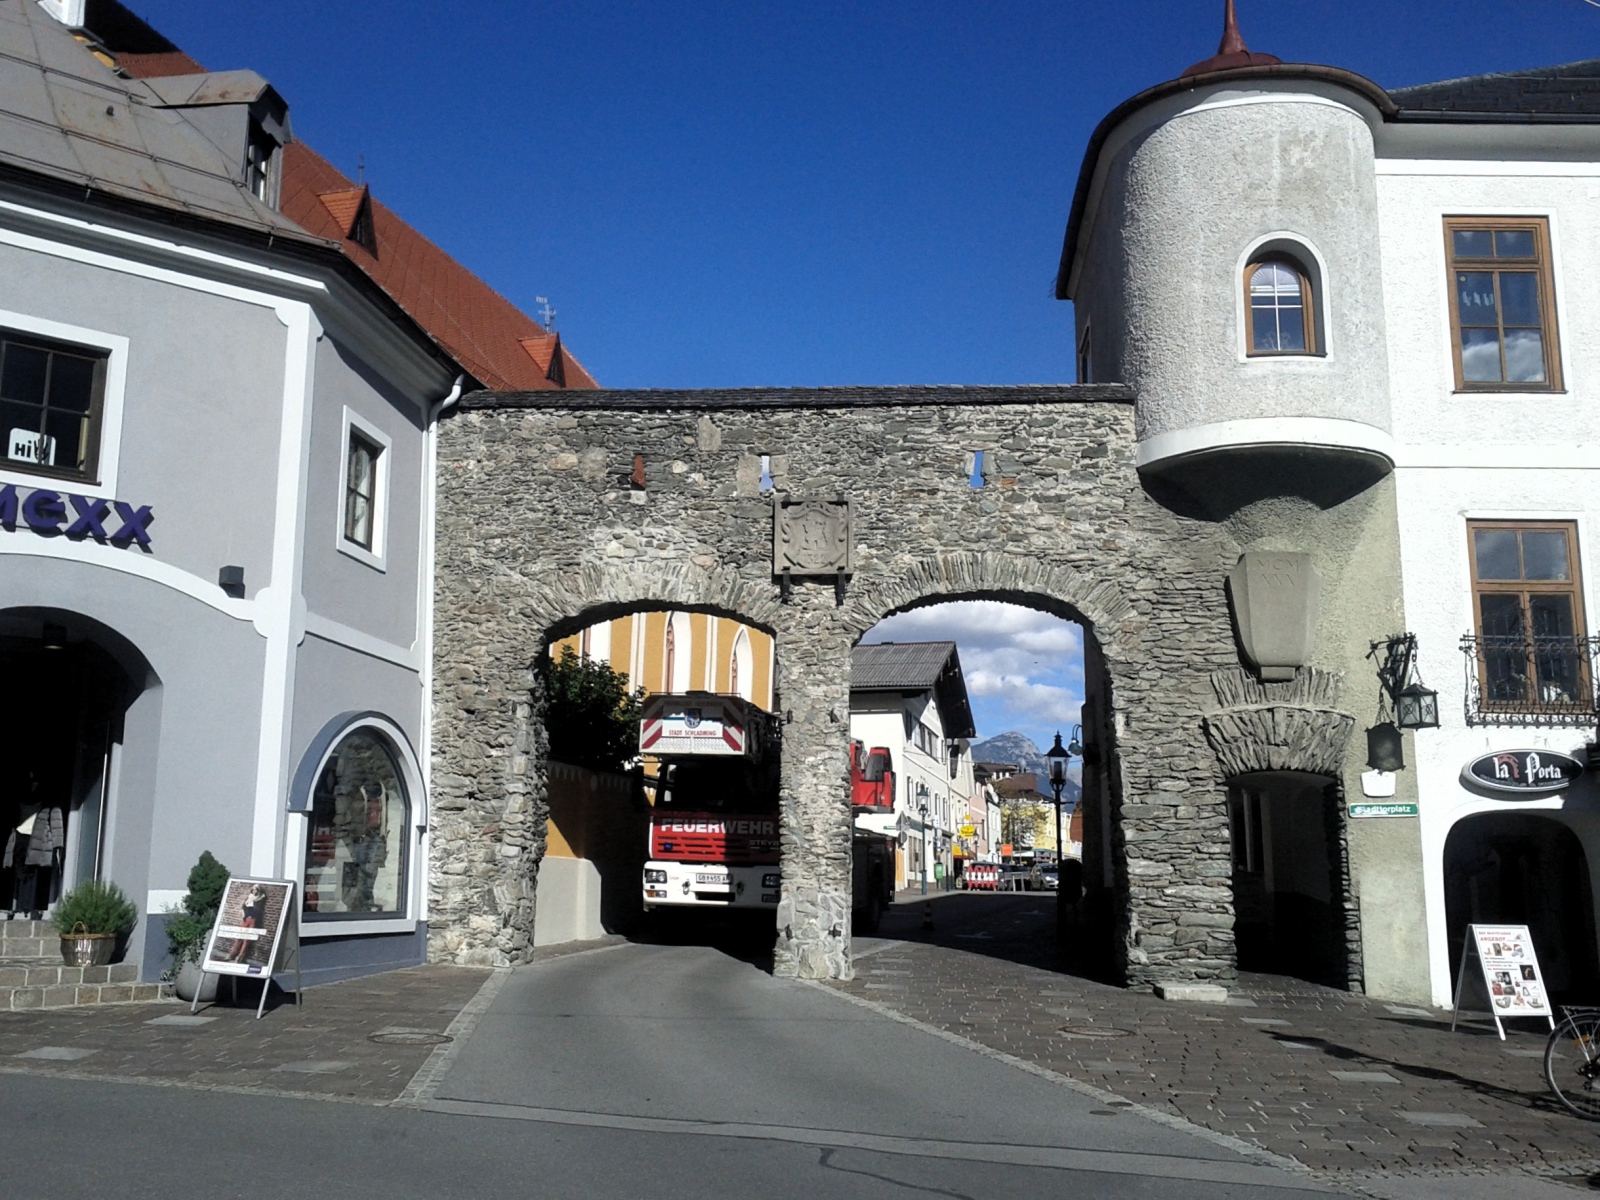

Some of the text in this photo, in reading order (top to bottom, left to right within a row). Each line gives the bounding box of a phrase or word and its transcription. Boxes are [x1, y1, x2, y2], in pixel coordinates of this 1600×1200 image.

[14, 440, 32, 458] Hi
[1525, 752, 1562, 784] Porta
[661, 818, 775, 835] FEUERWEHR
